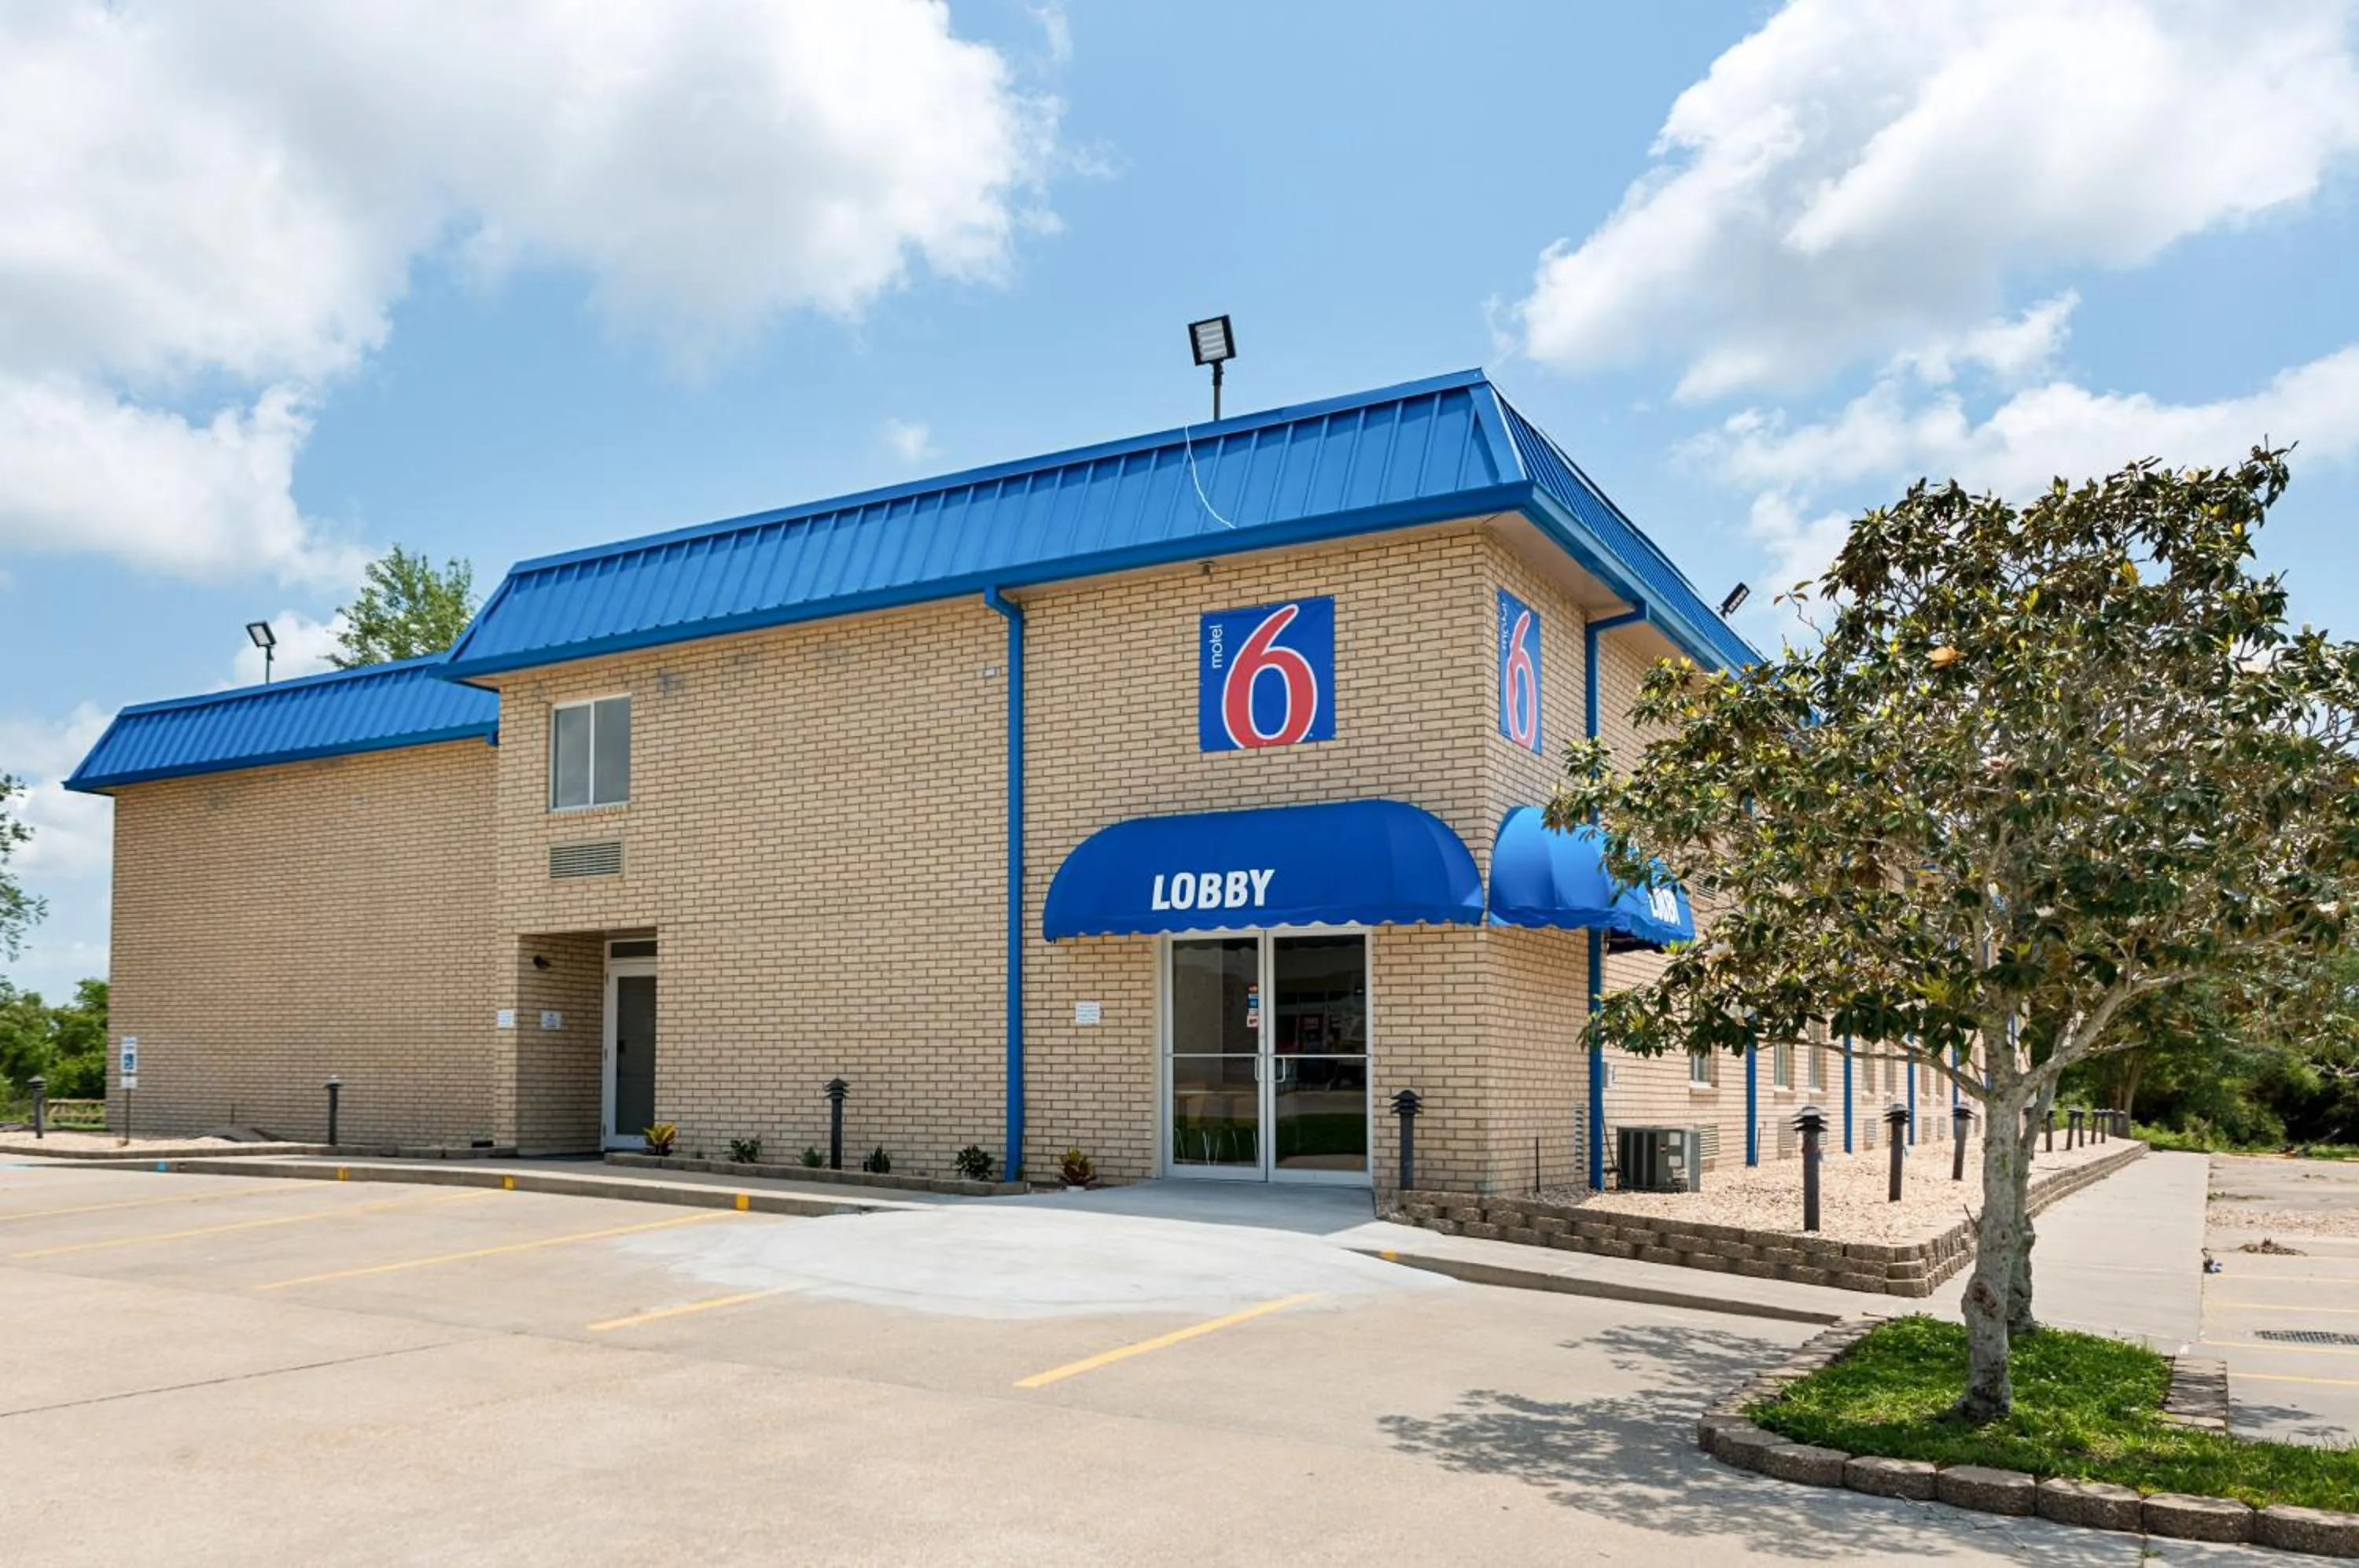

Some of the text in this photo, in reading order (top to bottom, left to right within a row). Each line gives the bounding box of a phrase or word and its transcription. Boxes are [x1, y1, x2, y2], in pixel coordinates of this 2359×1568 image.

[1209, 624, 1223, 668] motel
[1221, 604, 1318, 749] 6
[1506, 610, 1536, 750] 6
[1151, 869, 1275, 911] LOBBY
